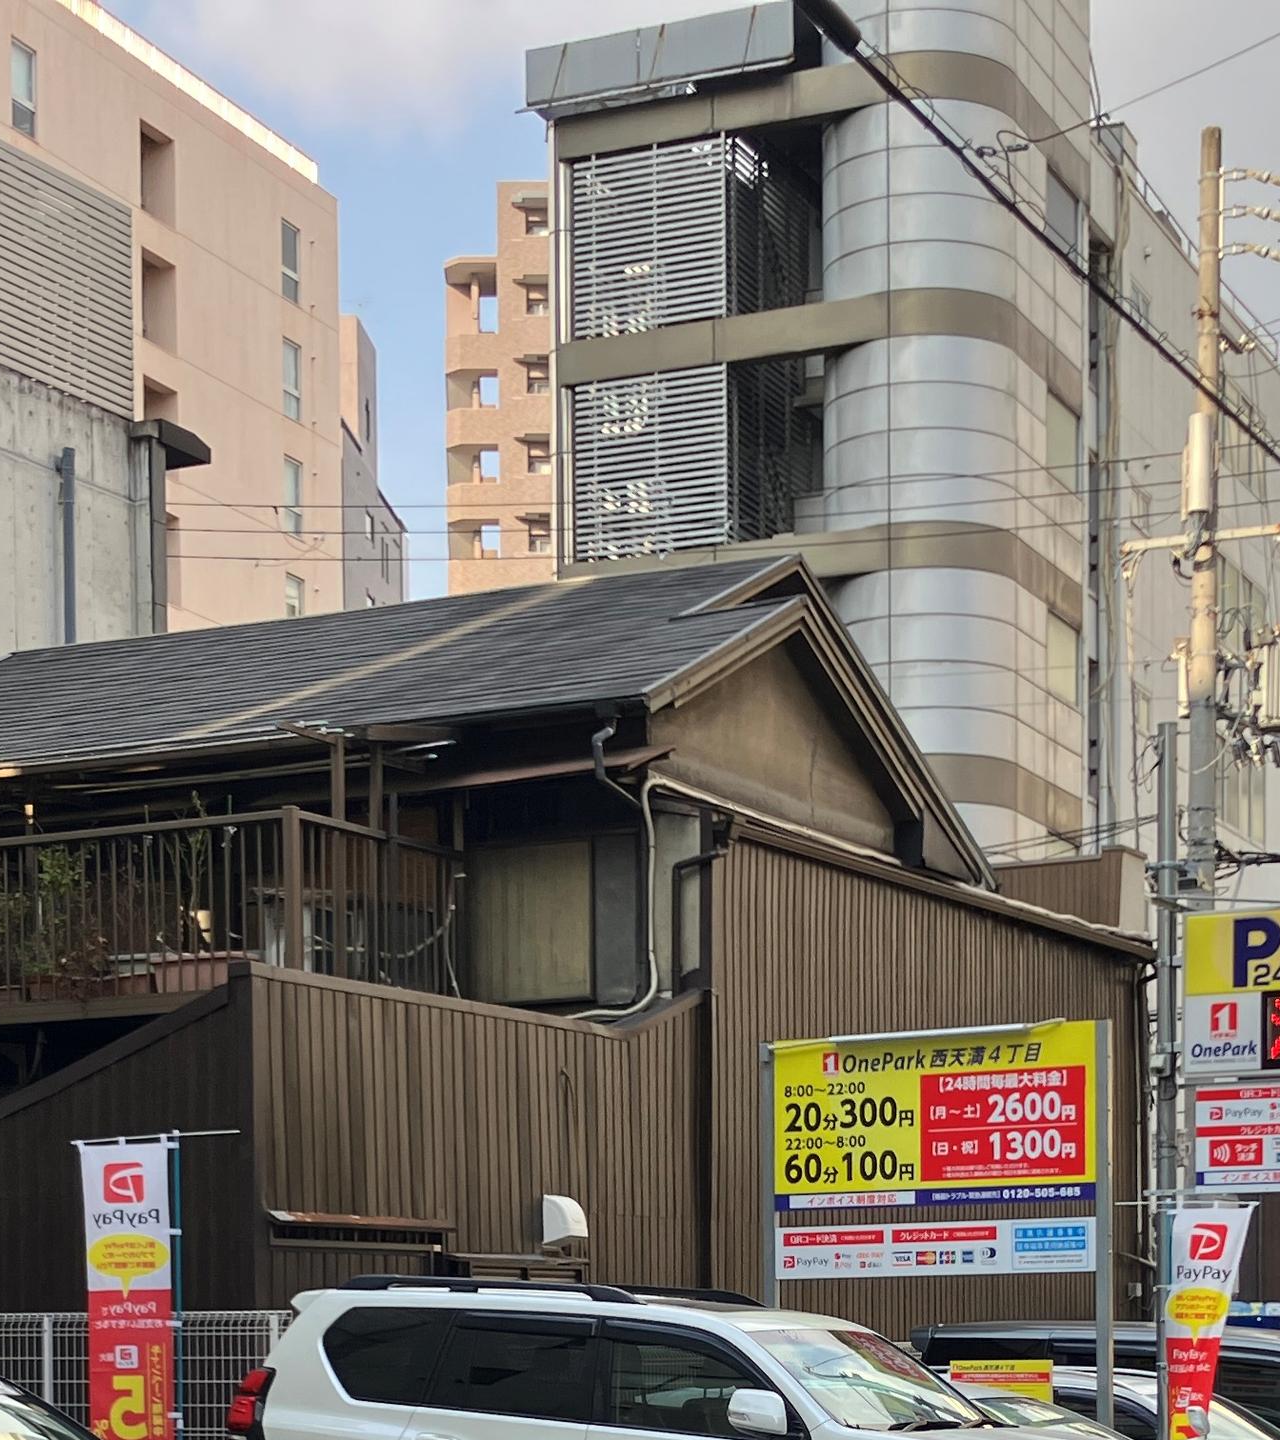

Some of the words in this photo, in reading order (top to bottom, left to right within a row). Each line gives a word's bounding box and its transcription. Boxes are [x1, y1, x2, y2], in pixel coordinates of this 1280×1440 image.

[1192, 1040, 1257, 1058] OnePark
[843, 1049, 926, 1073] OnePark
[784, 1097, 914, 1132] 20分300円
[987, 1091, 1076, 1123] 2600円
[1225, 1108, 1263, 1118] PayPay
[989, 1129, 1076, 1160] 1300円
[785, 1150, 914, 1183] 60分100円
[900, 1231, 949, 1240] クレジットカード
[797, 1256, 829, 1267] PayPay
[1177, 1265, 1231, 1283] PayPay
